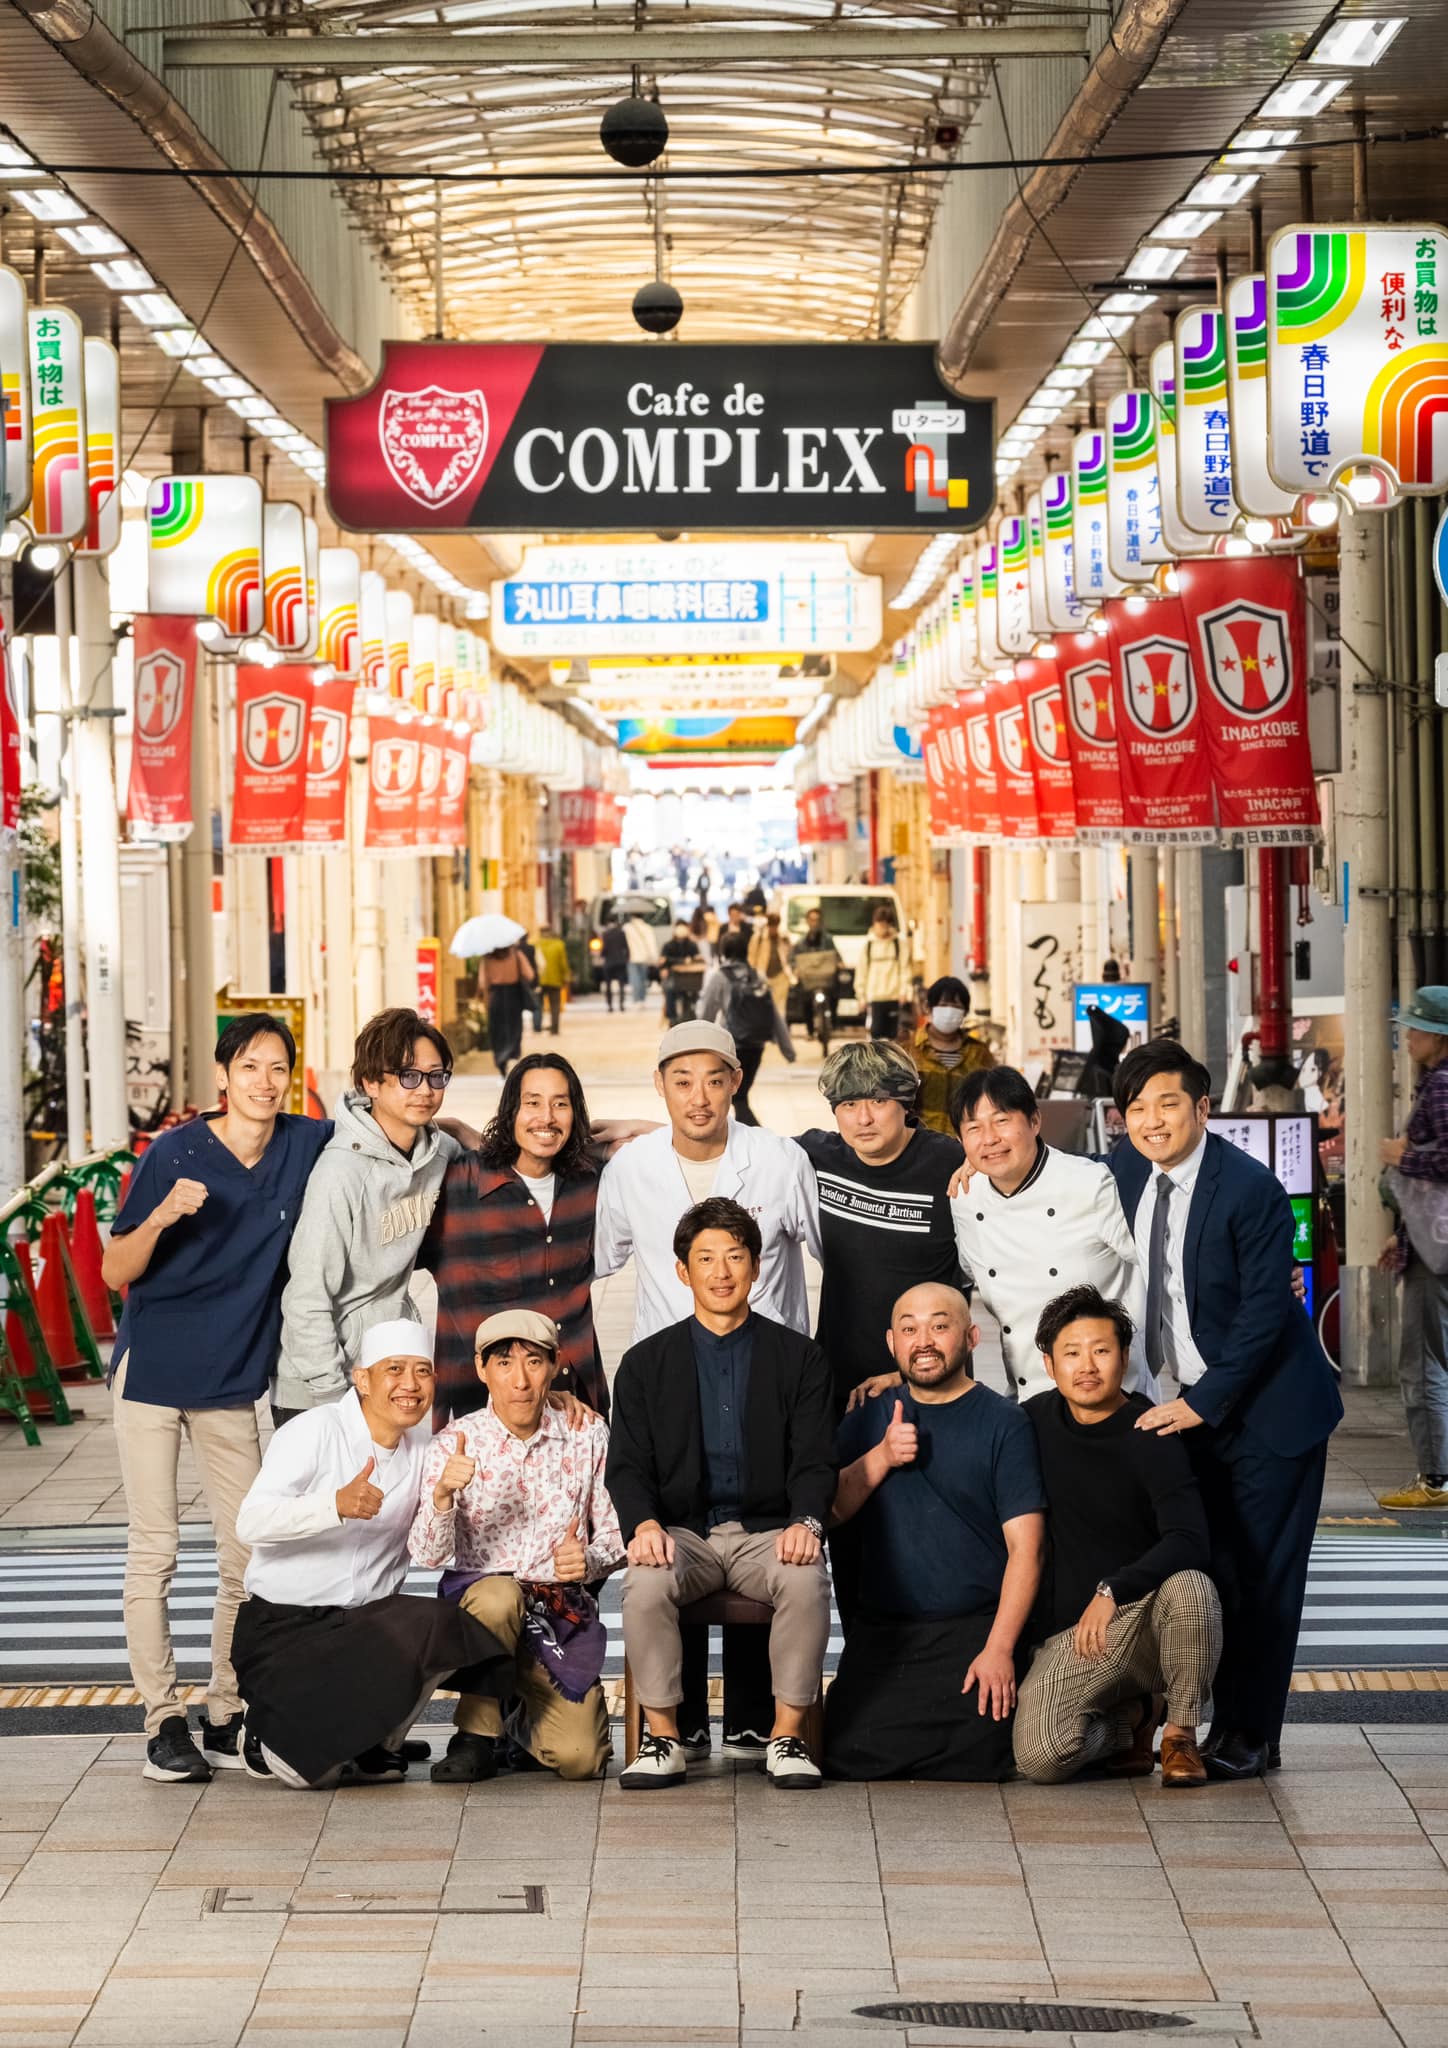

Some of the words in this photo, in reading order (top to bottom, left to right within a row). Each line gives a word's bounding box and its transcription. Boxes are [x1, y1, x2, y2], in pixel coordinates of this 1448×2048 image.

[1380, 271, 1406, 350] 便利な
[1414, 238, 1438, 336] お買物は
[36, 317, 63, 405] お買物は
[627, 382, 710, 417] Cafe
[723, 382, 765, 417] de
[1300, 343, 1331, 477] 春日野道で
[400, 433, 467, 448] COMPLEX
[513, 427, 887, 494] COMPLEX
[1203, 410, 1232, 517] 春日野道で
[1130, 741, 1162, 755] INAC
[1163, 739, 1197, 753] KOBE
[1221, 724, 1260, 741] INAC
[1261, 721, 1300, 737] KOBE
[1240, 741, 1265, 751] SINCE
[1266, 739, 1288, 749] 2001
[1247, 797, 1302, 812] INAC神戸
[1027, 933, 1059, 1030] つくも
[848, 1195, 886, 1215] Immortal
